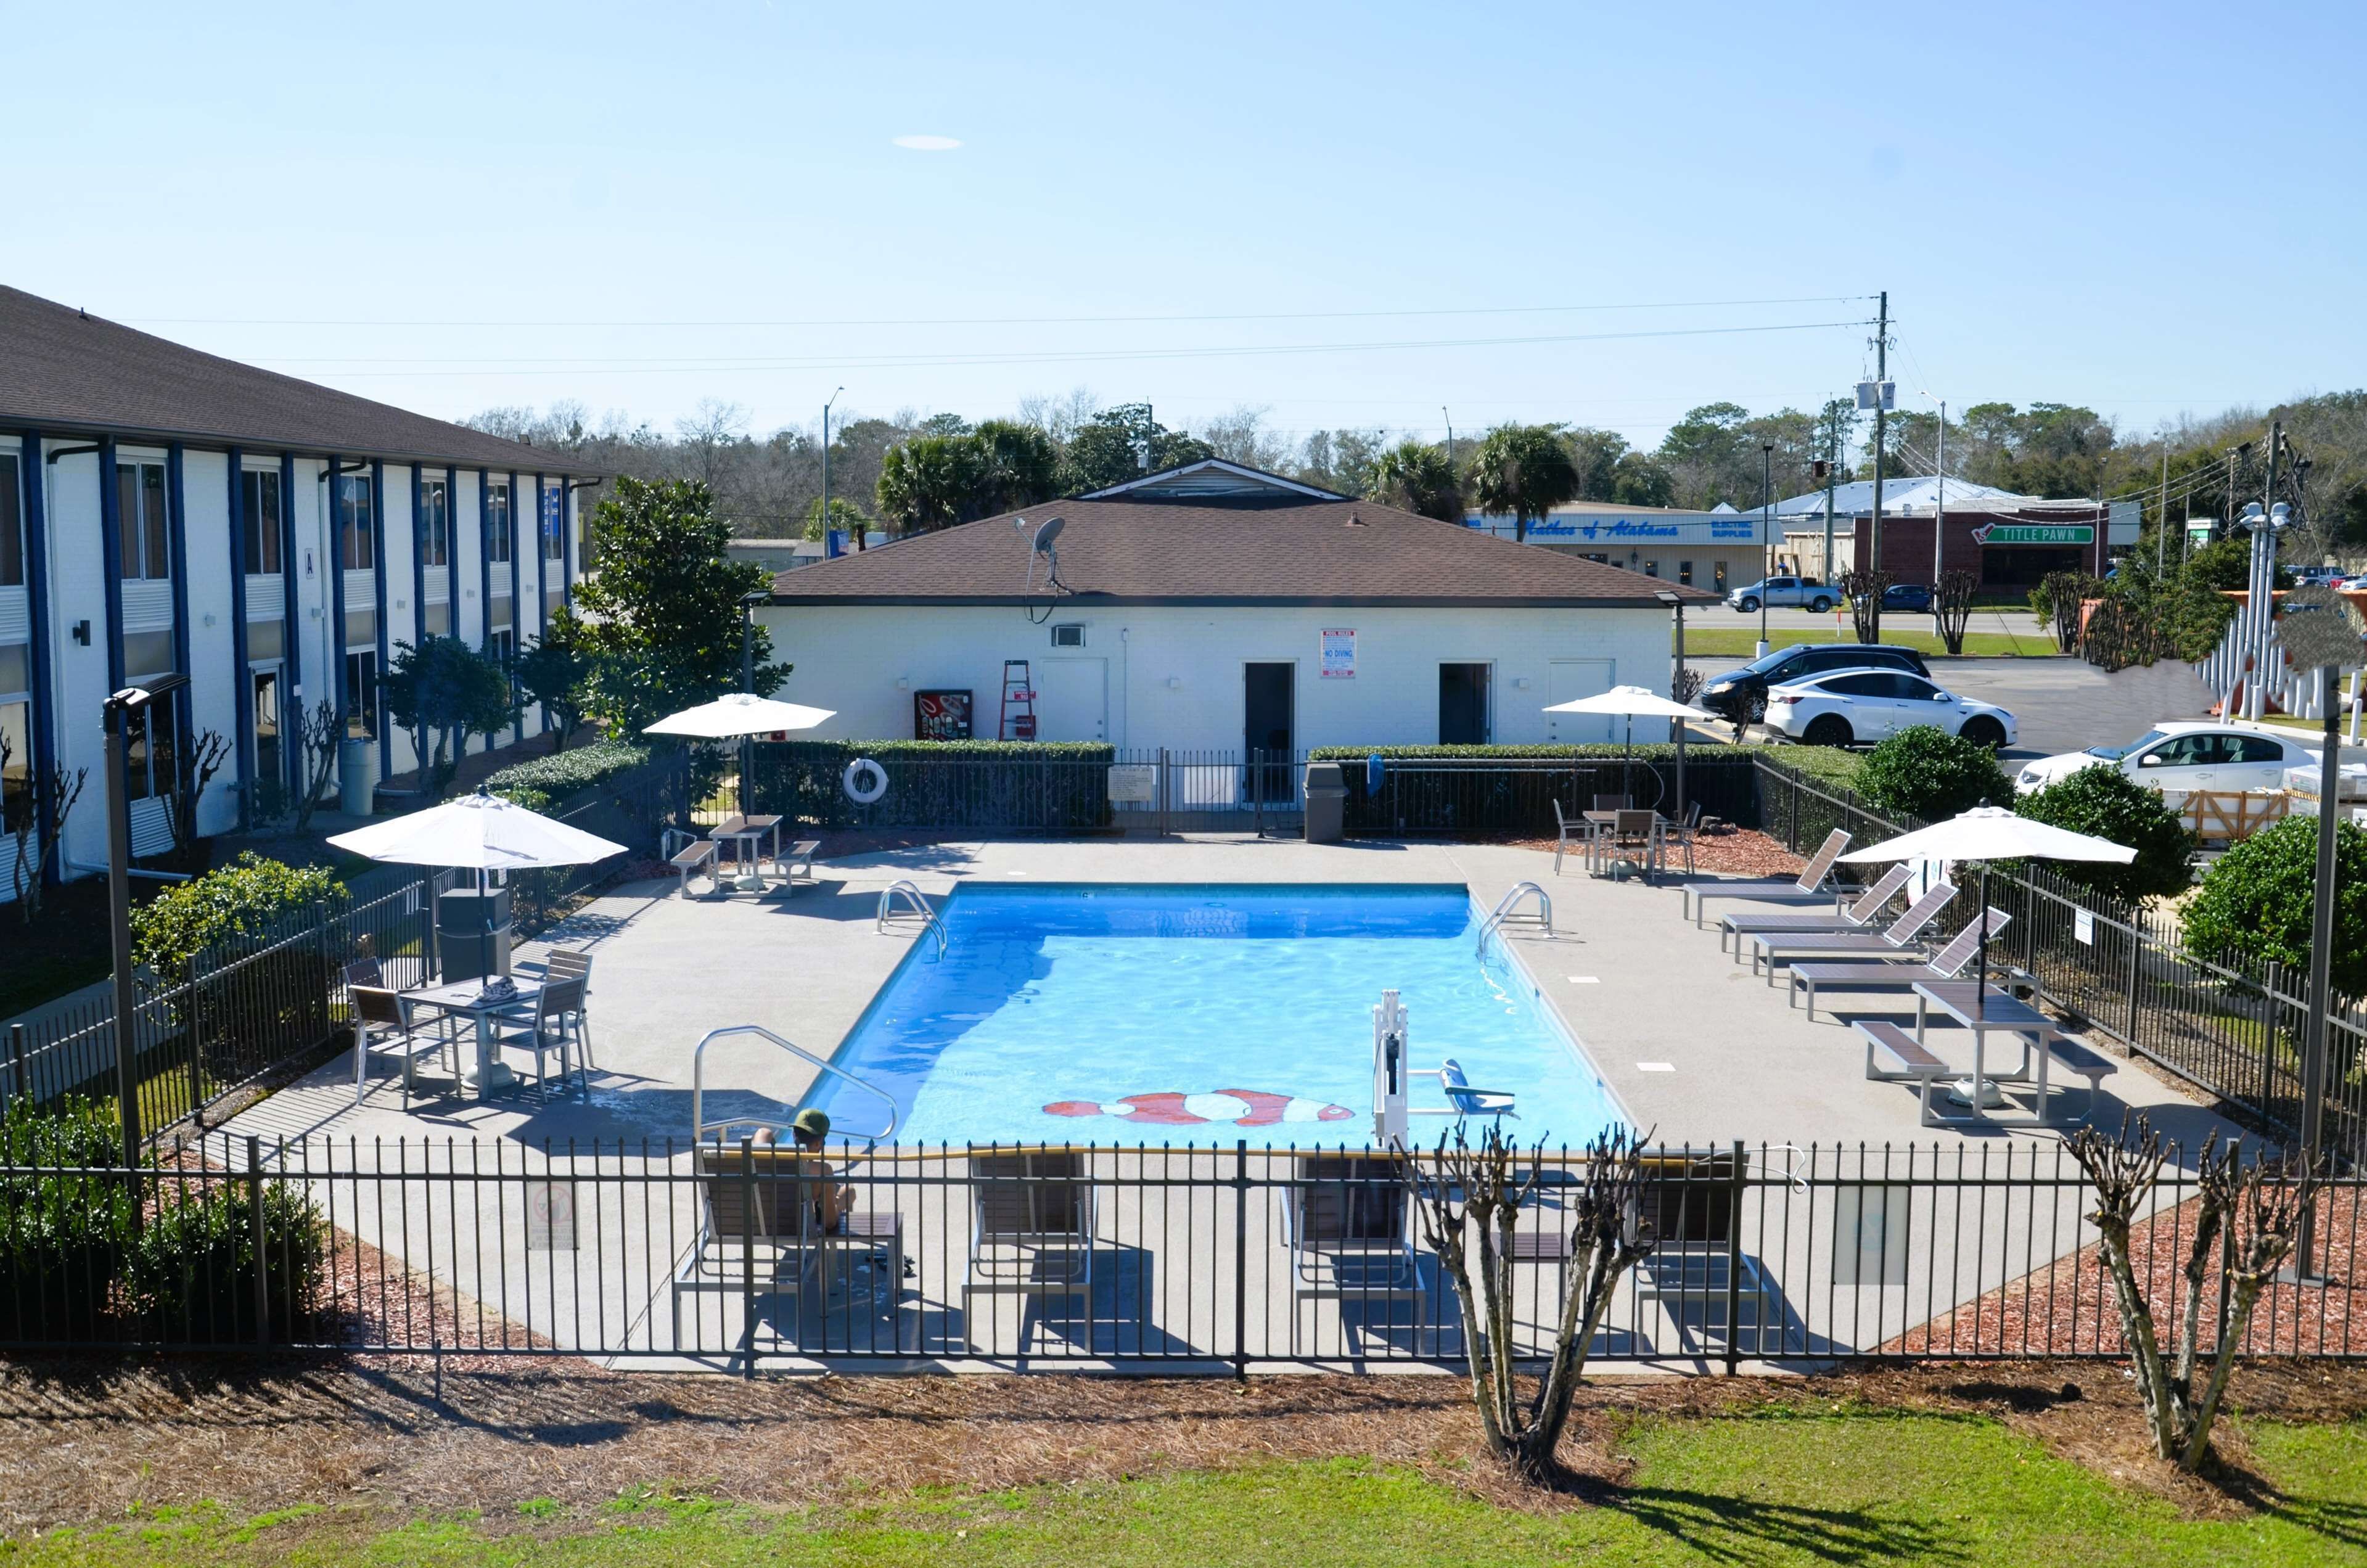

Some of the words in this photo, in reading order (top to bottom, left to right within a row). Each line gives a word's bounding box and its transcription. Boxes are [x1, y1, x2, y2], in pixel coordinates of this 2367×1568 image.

[1583, 520, 1598, 539] of
[2003, 529, 2037, 540] TITLE
[2042, 529, 2075, 540] PAWN
[308, 553, 313, 574] A
